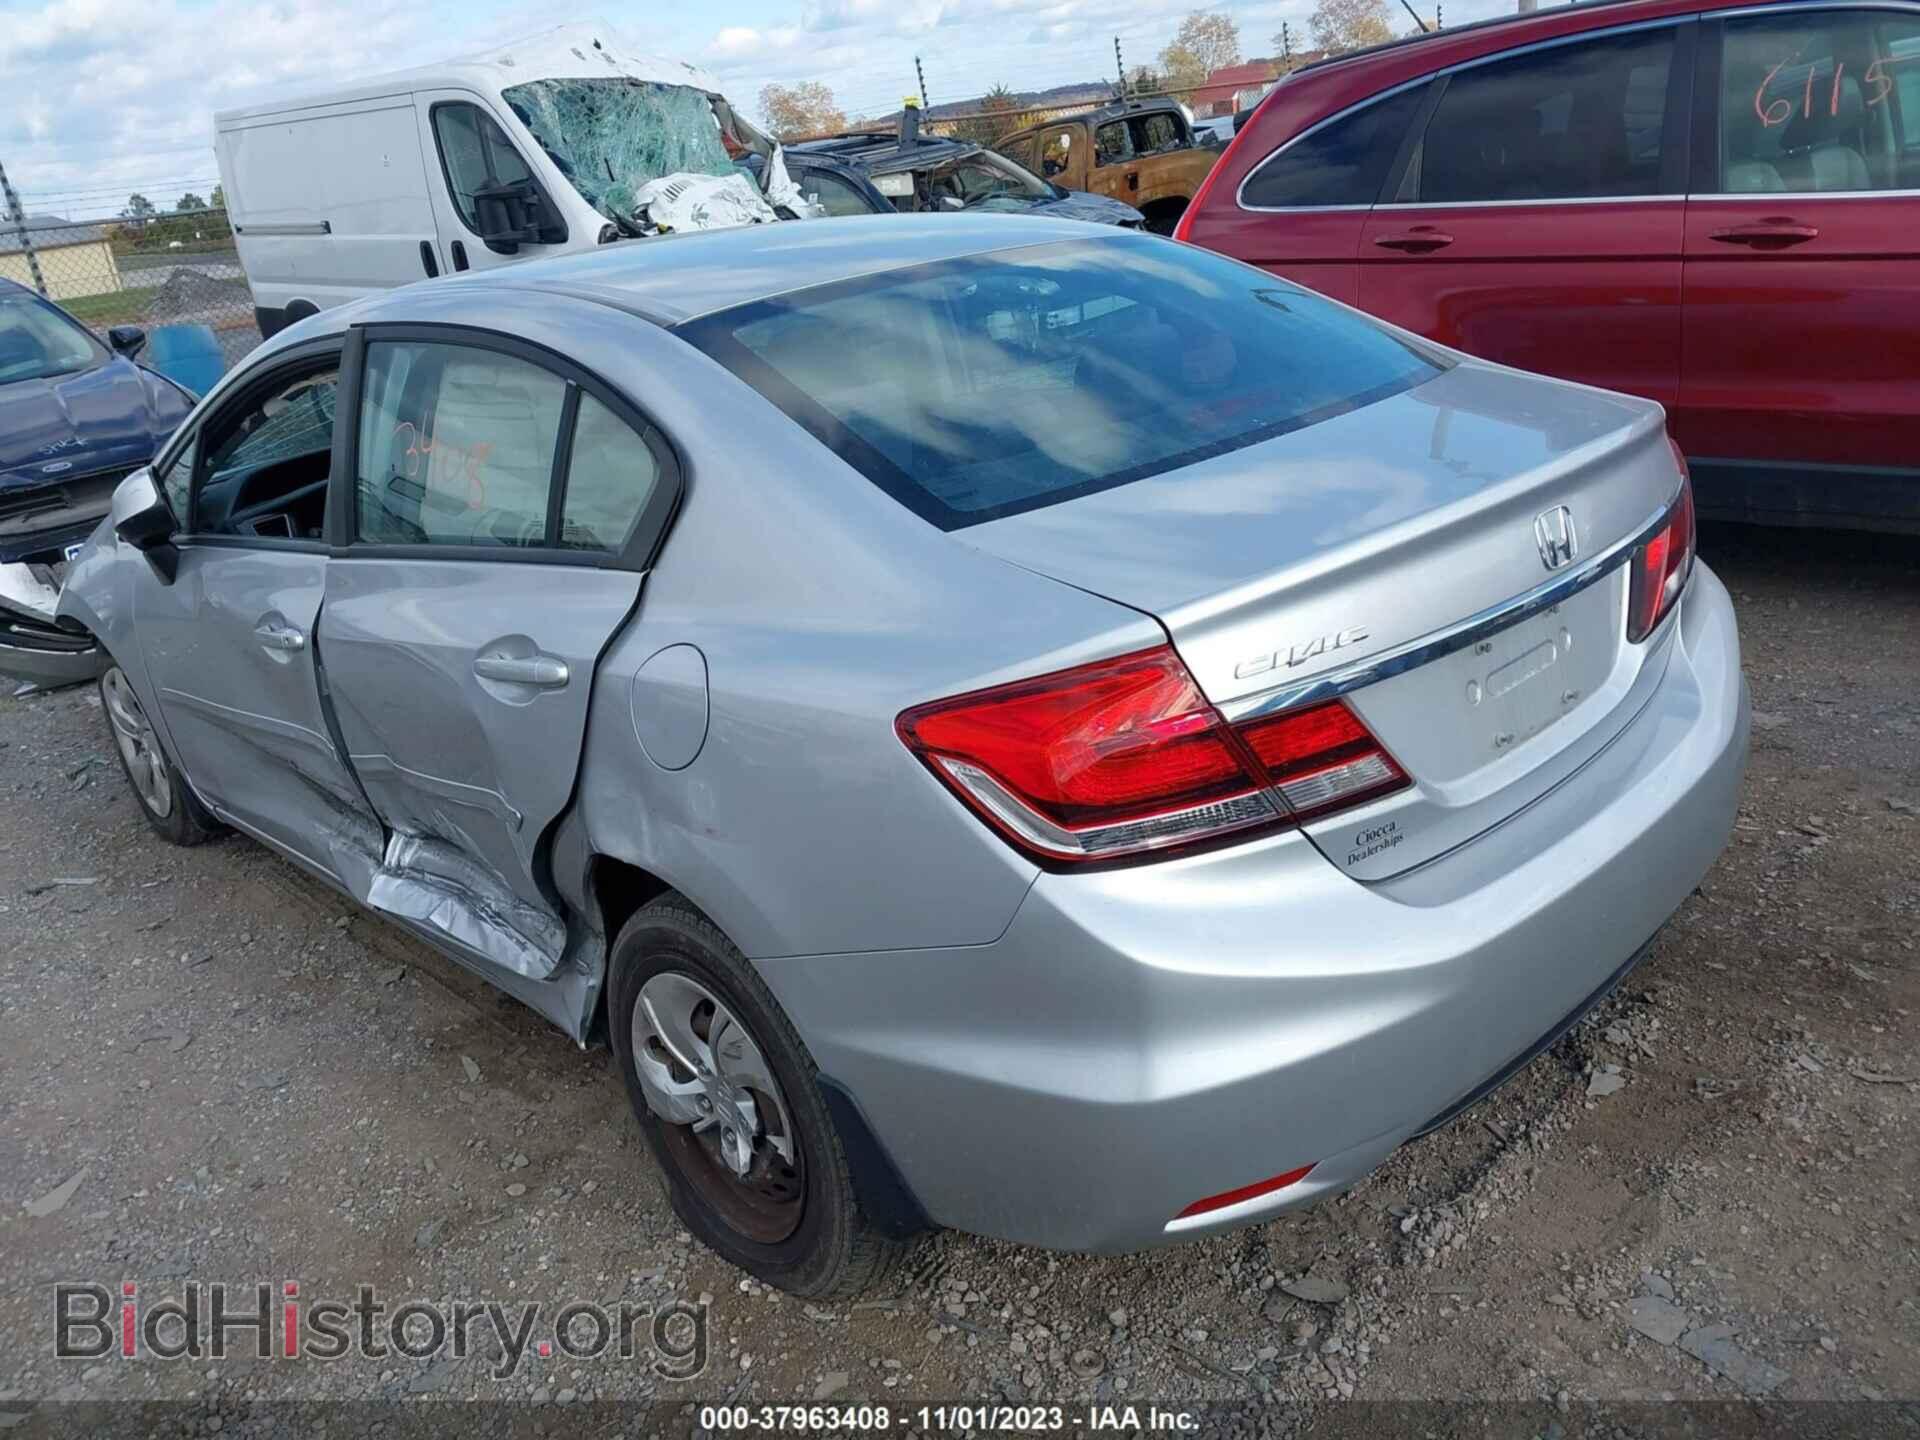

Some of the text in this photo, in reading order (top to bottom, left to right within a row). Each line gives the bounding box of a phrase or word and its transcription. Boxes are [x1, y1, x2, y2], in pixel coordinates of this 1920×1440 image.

[1755, 52, 1920, 127] 6115
[1234, 624, 1369, 680] CIVIC
[1347, 834, 1404, 866] Dealerships
[1356, 821, 1396, 846] Ciocca
